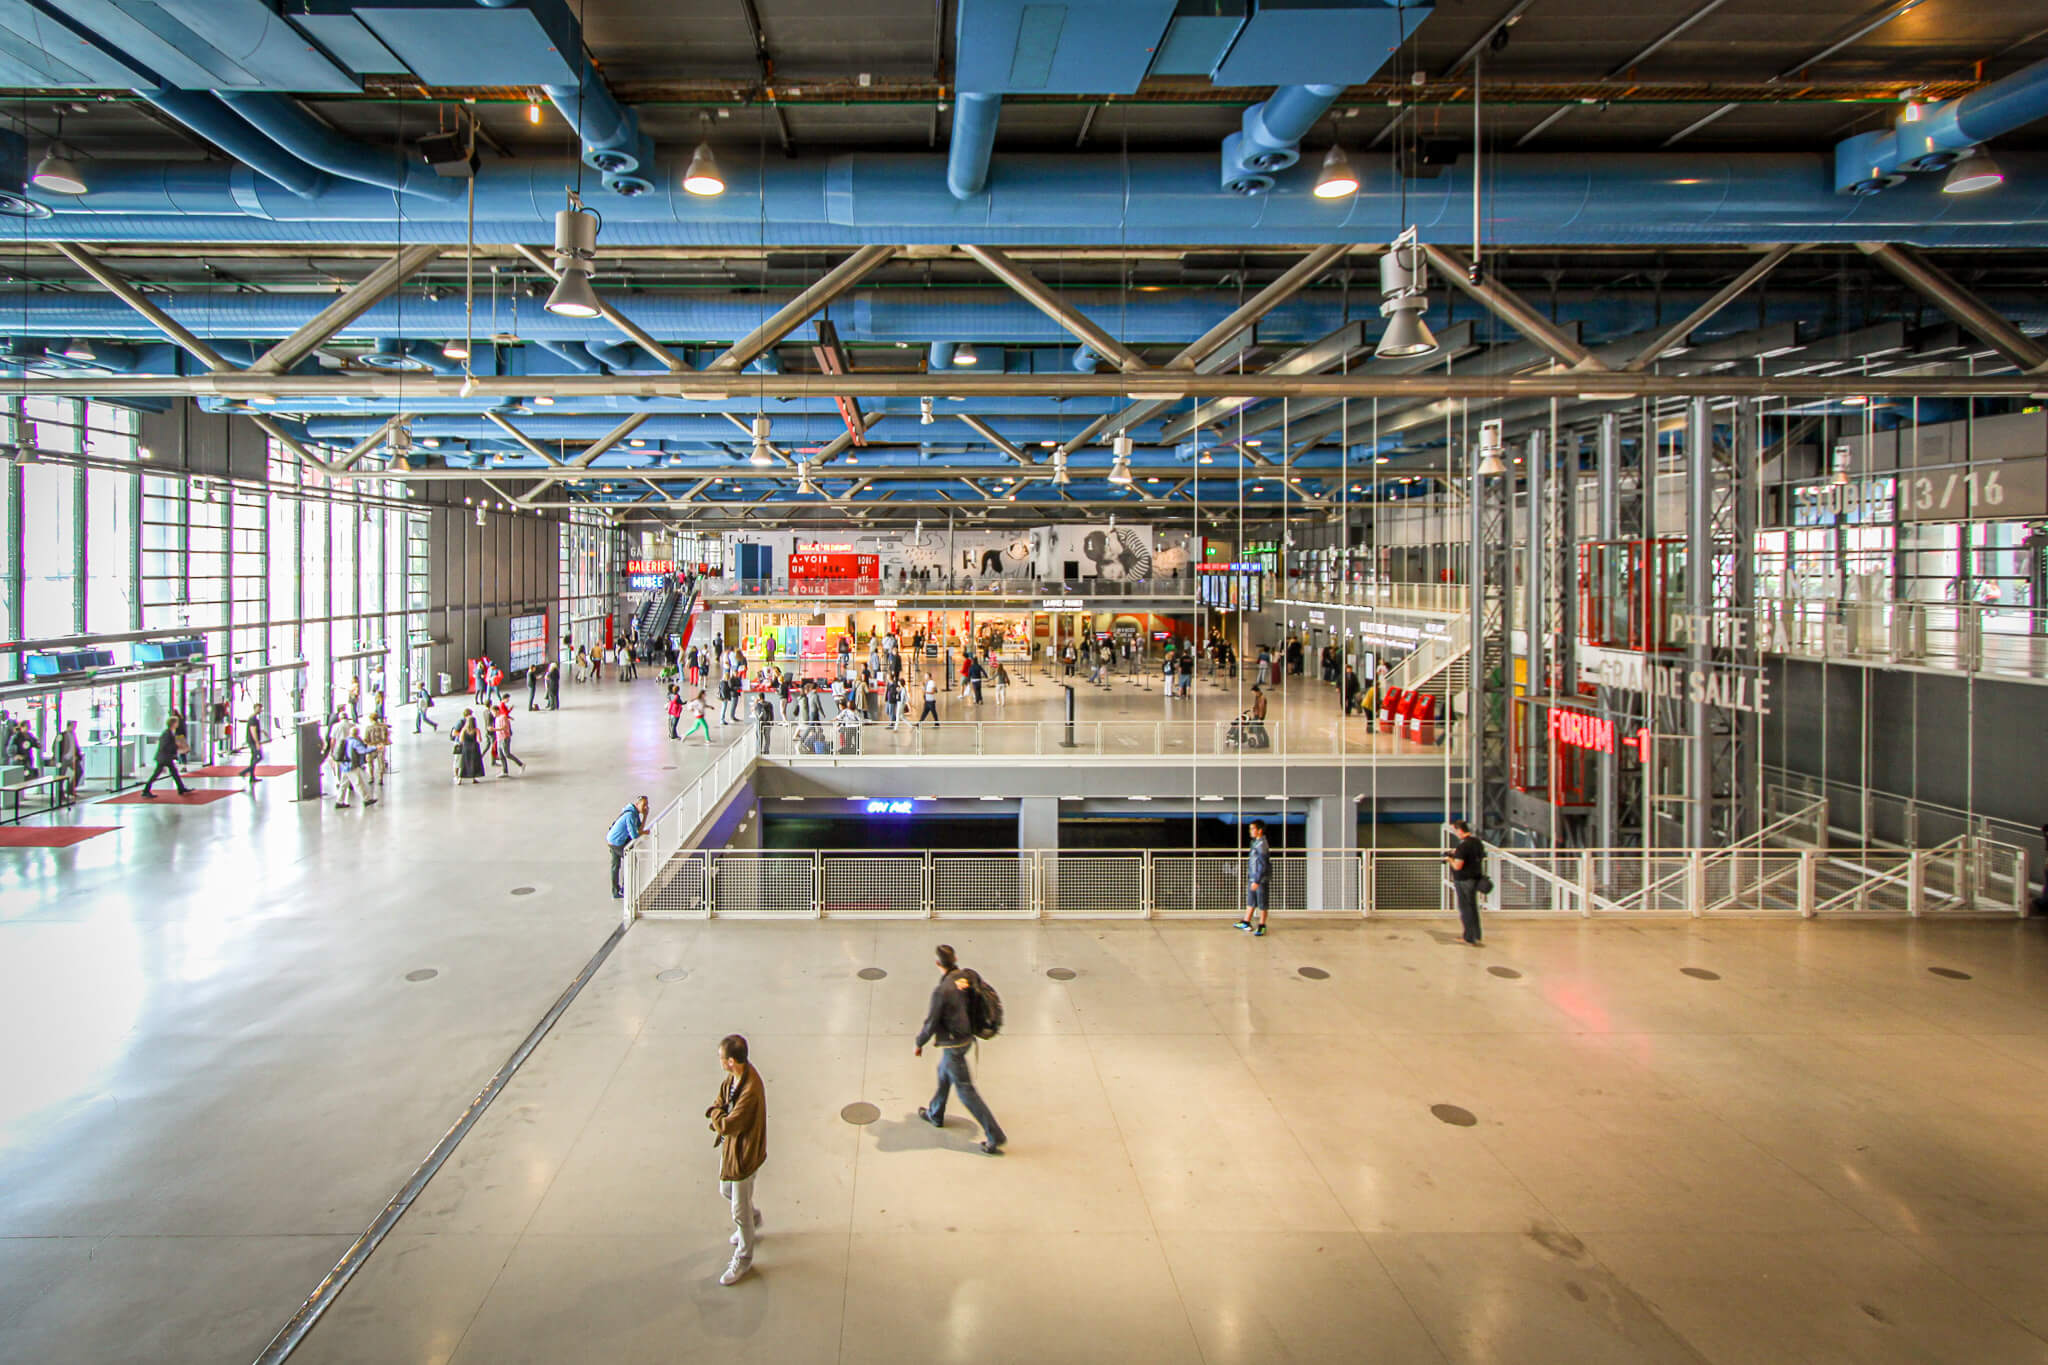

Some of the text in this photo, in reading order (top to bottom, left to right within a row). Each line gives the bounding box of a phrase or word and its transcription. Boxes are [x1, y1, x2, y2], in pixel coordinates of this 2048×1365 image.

[1799, 471, 2005, 517] STUDIO 13/16
[629, 560, 665, 572] GALERIE
[1670, 613, 1749, 649] PETITE
[1600, 658, 1772, 715] GRANDE SALLE
[1548, 707, 1614, 755] FORUM
